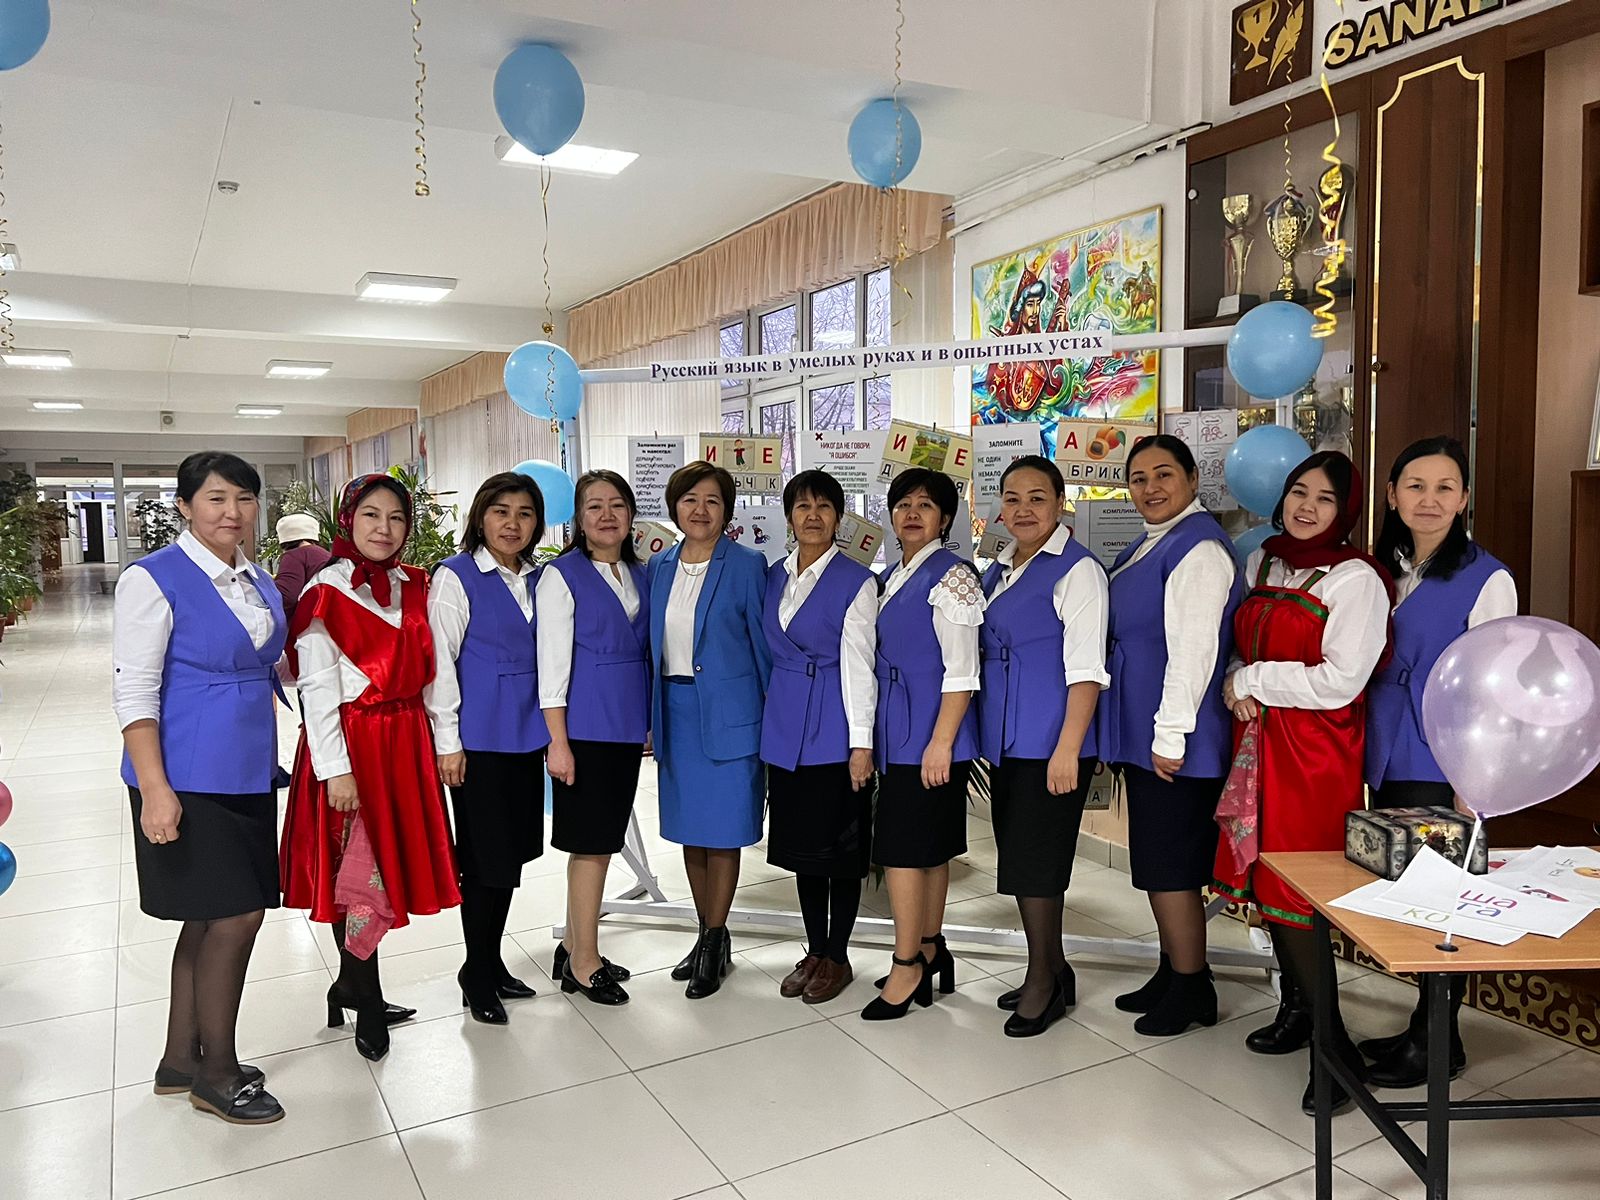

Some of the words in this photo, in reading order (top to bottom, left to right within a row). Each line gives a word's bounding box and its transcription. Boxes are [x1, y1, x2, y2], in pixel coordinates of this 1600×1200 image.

[651, 361, 718, 381] Русский
[724, 361, 767, 374] язык
[772, 360, 782, 372] в
[788, 353, 856, 373] умелых
[863, 348, 916, 369] руках
[921, 349, 932, 361] и
[938, 348, 949, 360] в
[953, 339, 1044, 360] опытных
[1048, 336, 1103, 356] устах
[892, 433, 908, 452] И
[988, 439, 1023, 448] ЗАПОМНИТЕ
[1063, 431, 1078, 450] А
[705, 445, 717, 462] И
[762, 447, 773, 464] Е
[954, 448, 969, 466] Е
[985, 455, 1001, 463] ОДИН
[859, 534, 875, 552] Е
